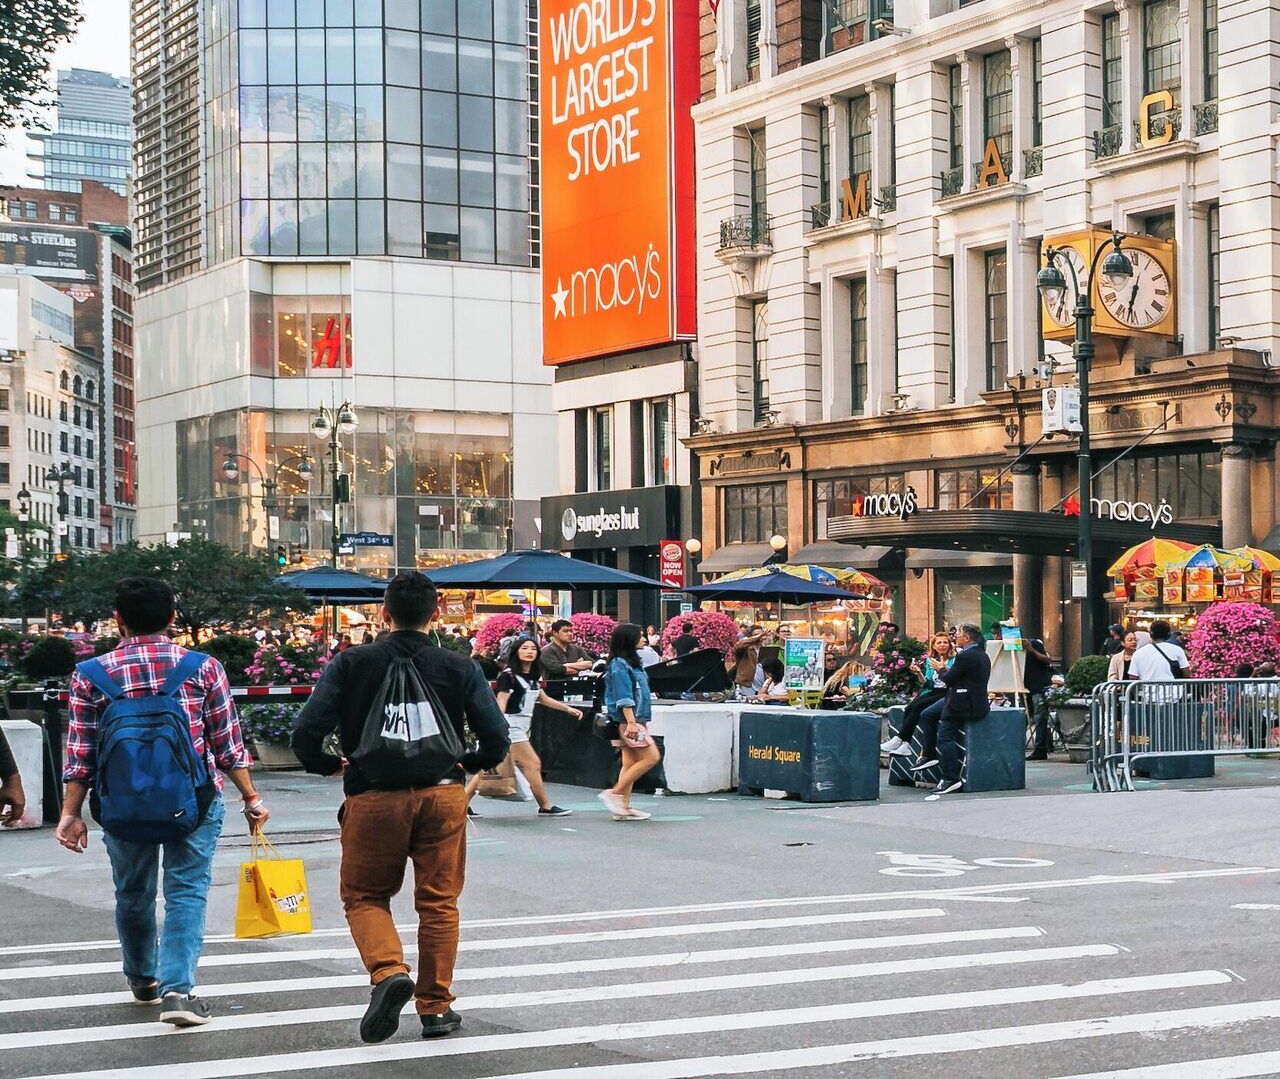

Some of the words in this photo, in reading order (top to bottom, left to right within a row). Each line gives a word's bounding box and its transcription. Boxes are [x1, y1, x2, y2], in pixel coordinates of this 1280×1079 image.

[551, 36, 654, 126] LARGEST
[567, 108, 641, 181] STORE
[31, 235, 77, 247] STEELERS
[577, 507, 621, 538] sunglass
[620, 505, 640, 530] hut
[346, 536, 366, 544] West
[748, 744, 773, 761] Herald
[774, 746, 801, 764] Square
